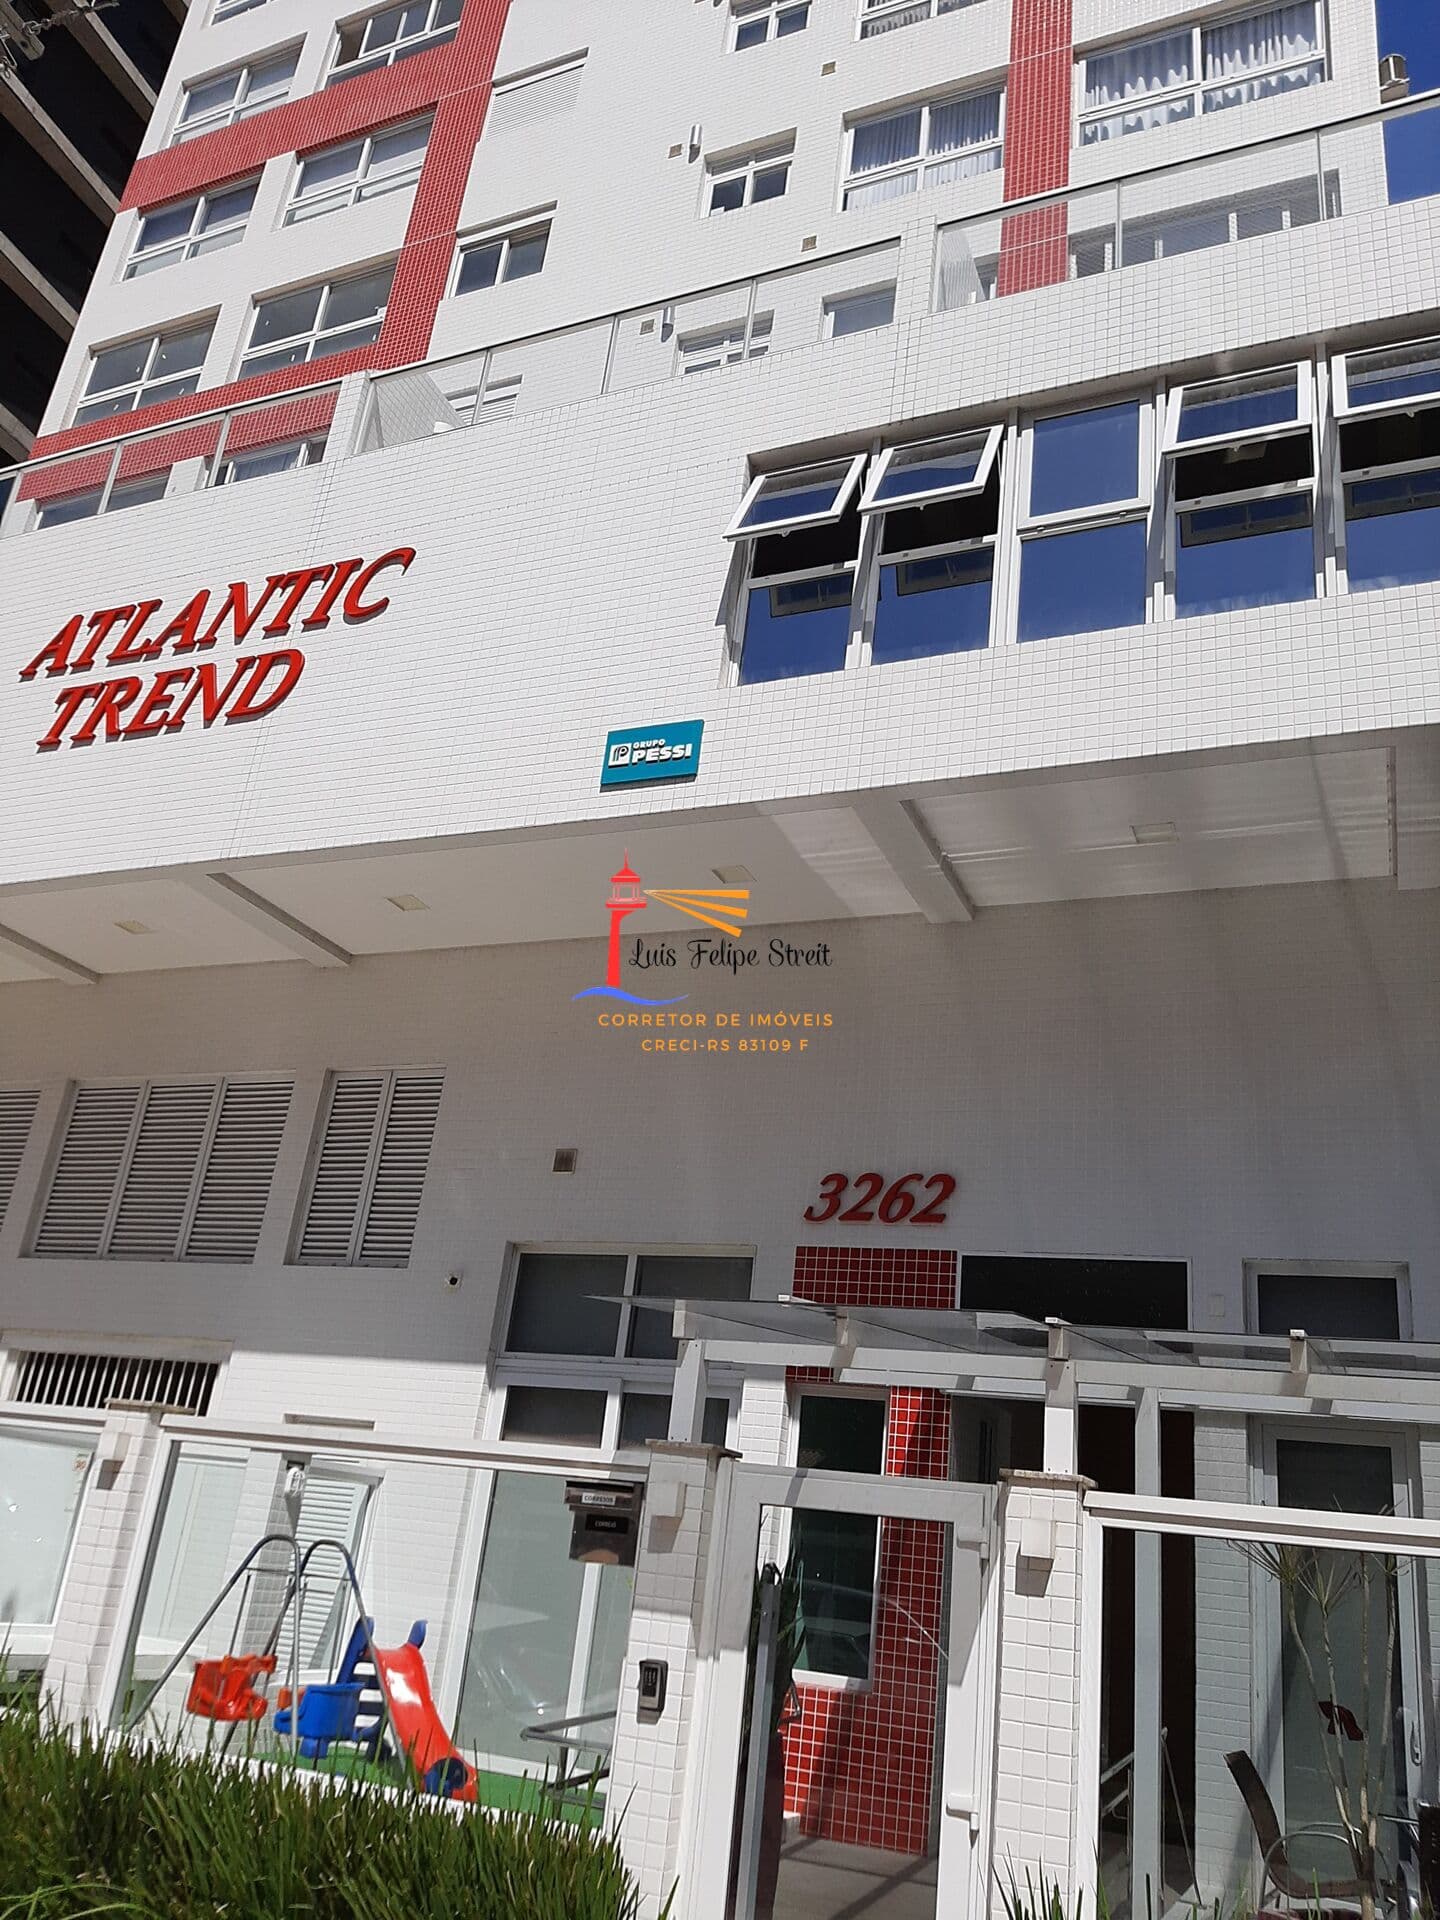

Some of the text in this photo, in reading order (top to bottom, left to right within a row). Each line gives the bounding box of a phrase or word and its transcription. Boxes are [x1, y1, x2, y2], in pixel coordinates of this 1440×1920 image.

[18, 547, 416, 682] ATLANTIC
[36, 648, 305, 753] TREND
[632, 744, 692, 764] PESSI
[633, 739, 666, 750] GRUPO
[803, 1172, 956, 1224] 3262
